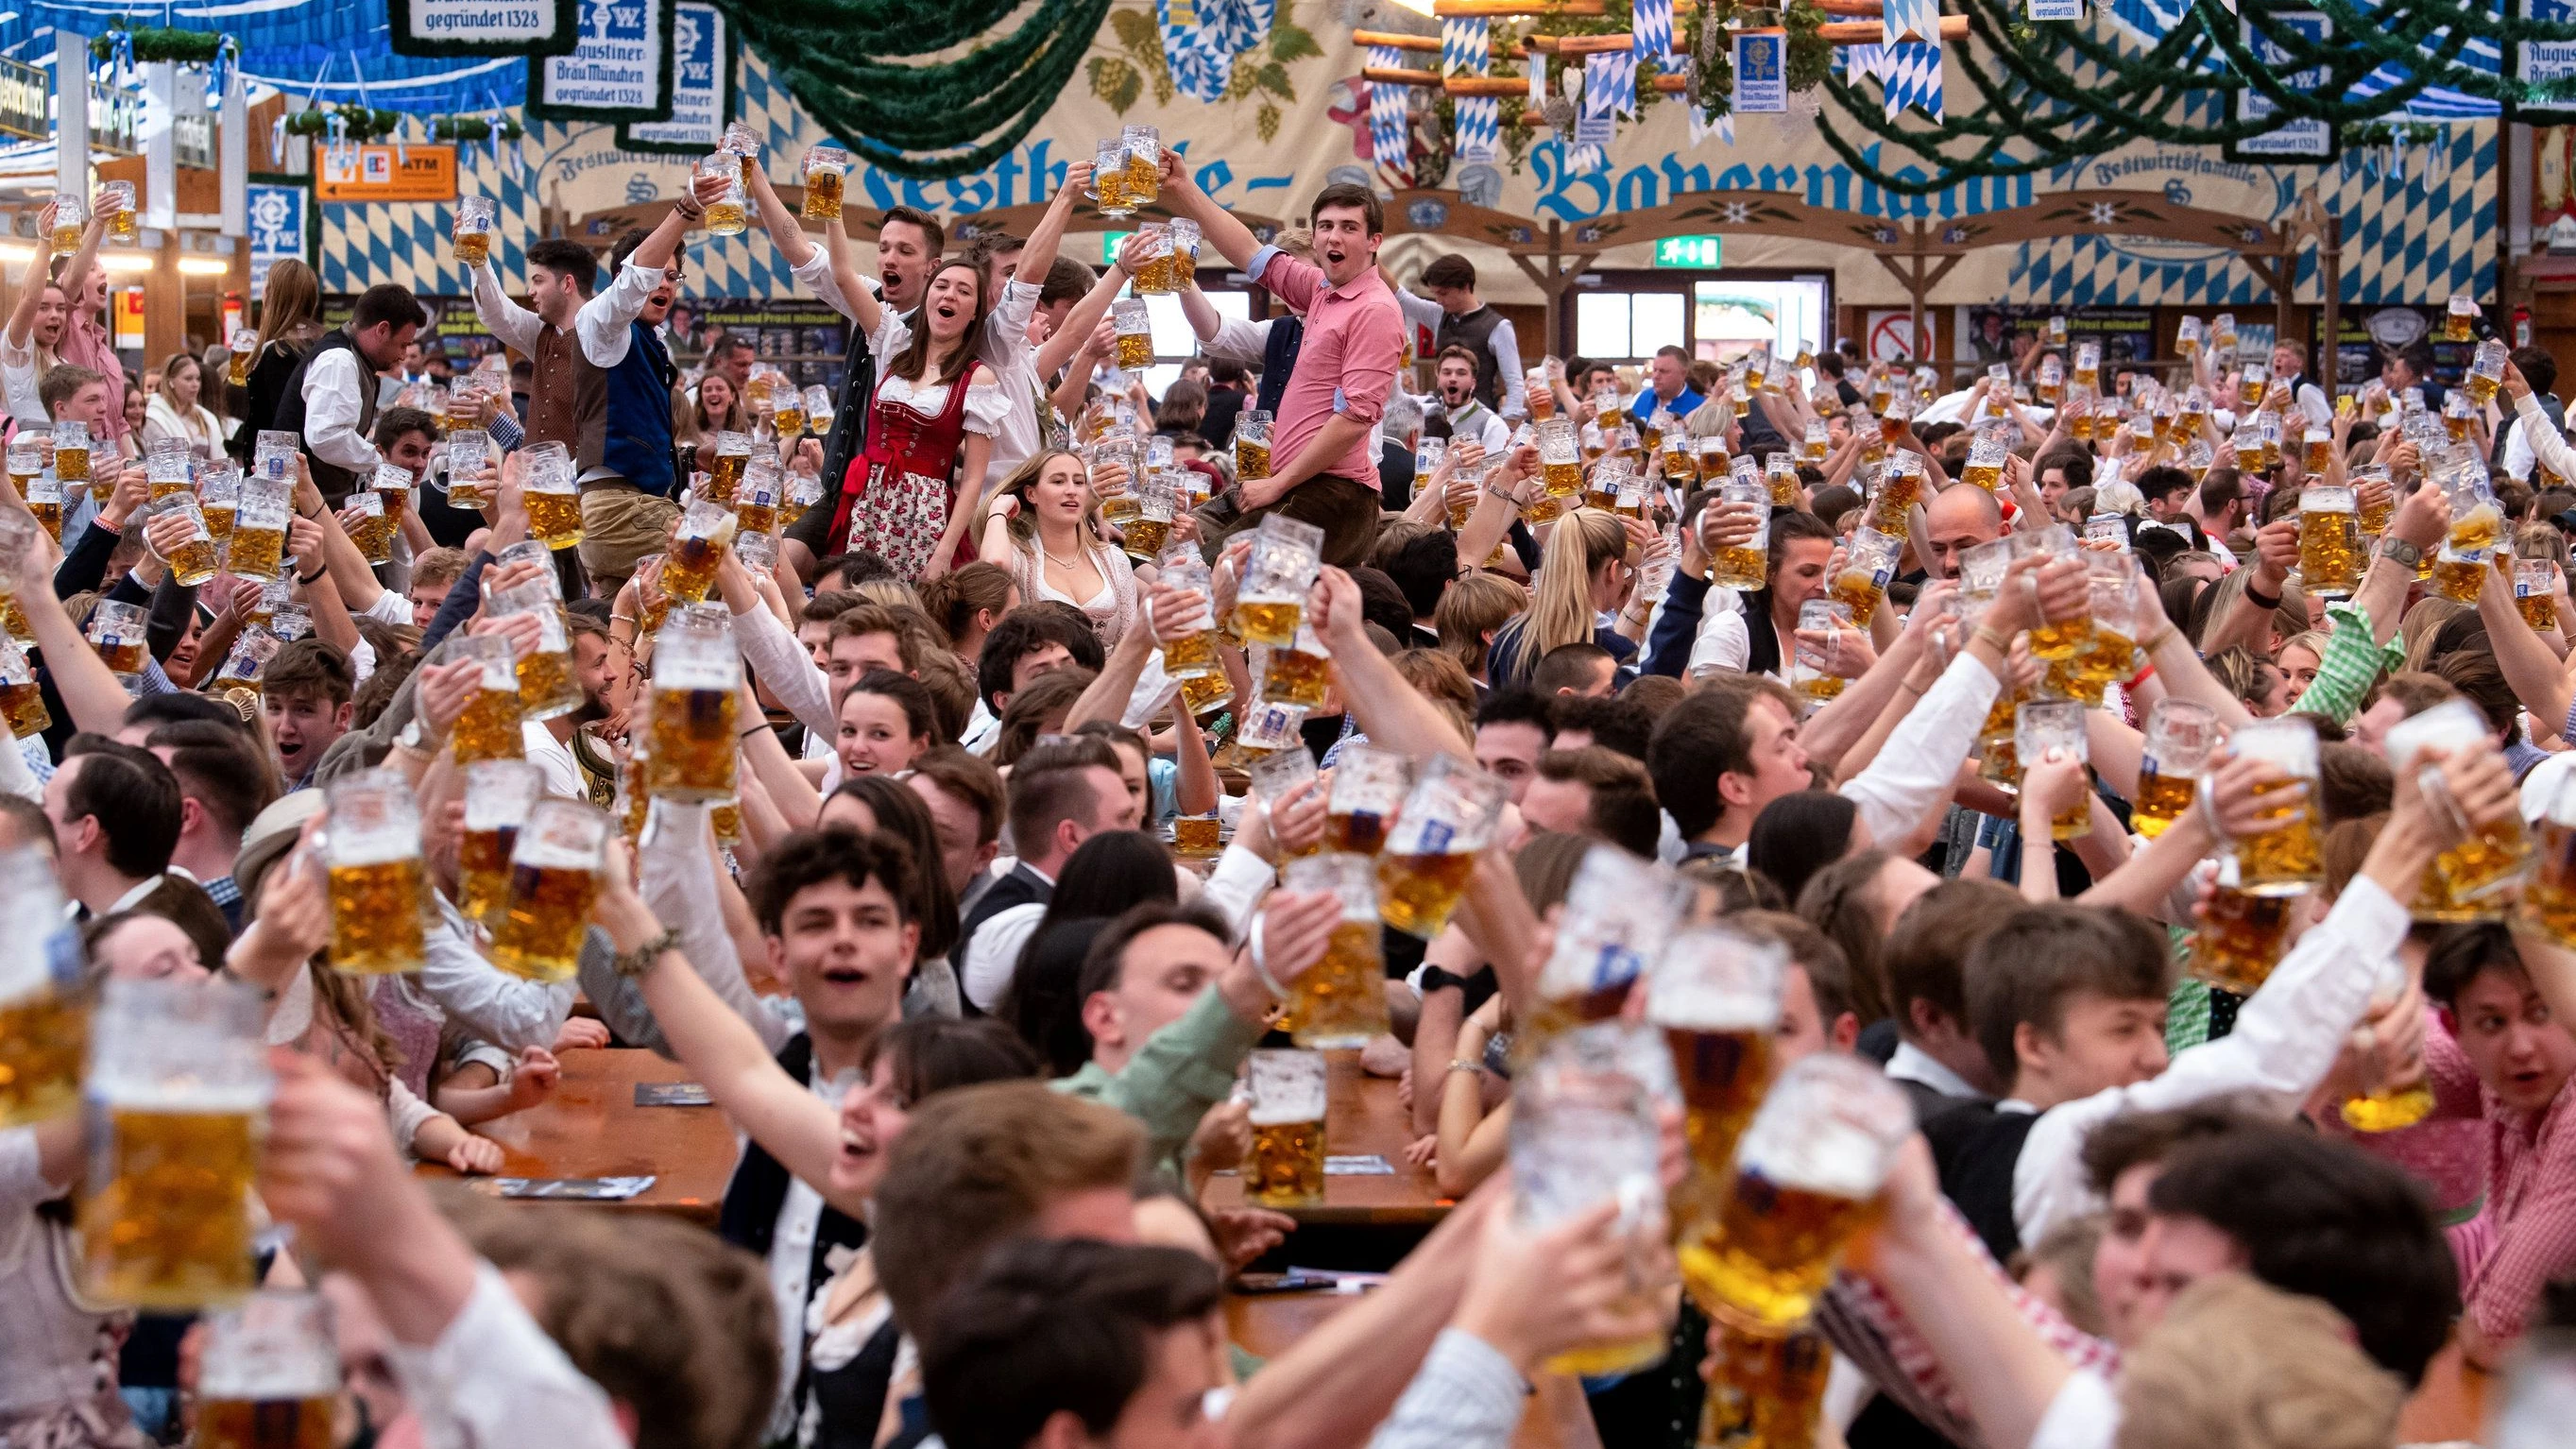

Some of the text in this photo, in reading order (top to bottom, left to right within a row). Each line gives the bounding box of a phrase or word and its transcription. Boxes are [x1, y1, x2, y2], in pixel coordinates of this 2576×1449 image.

[426, 9, 539, 31] gegründet 1328
[555, 60, 643, 83] Bräu München
[555, 85, 642, 103] gegründet 1328
[401, 158, 438, 170] ATM
